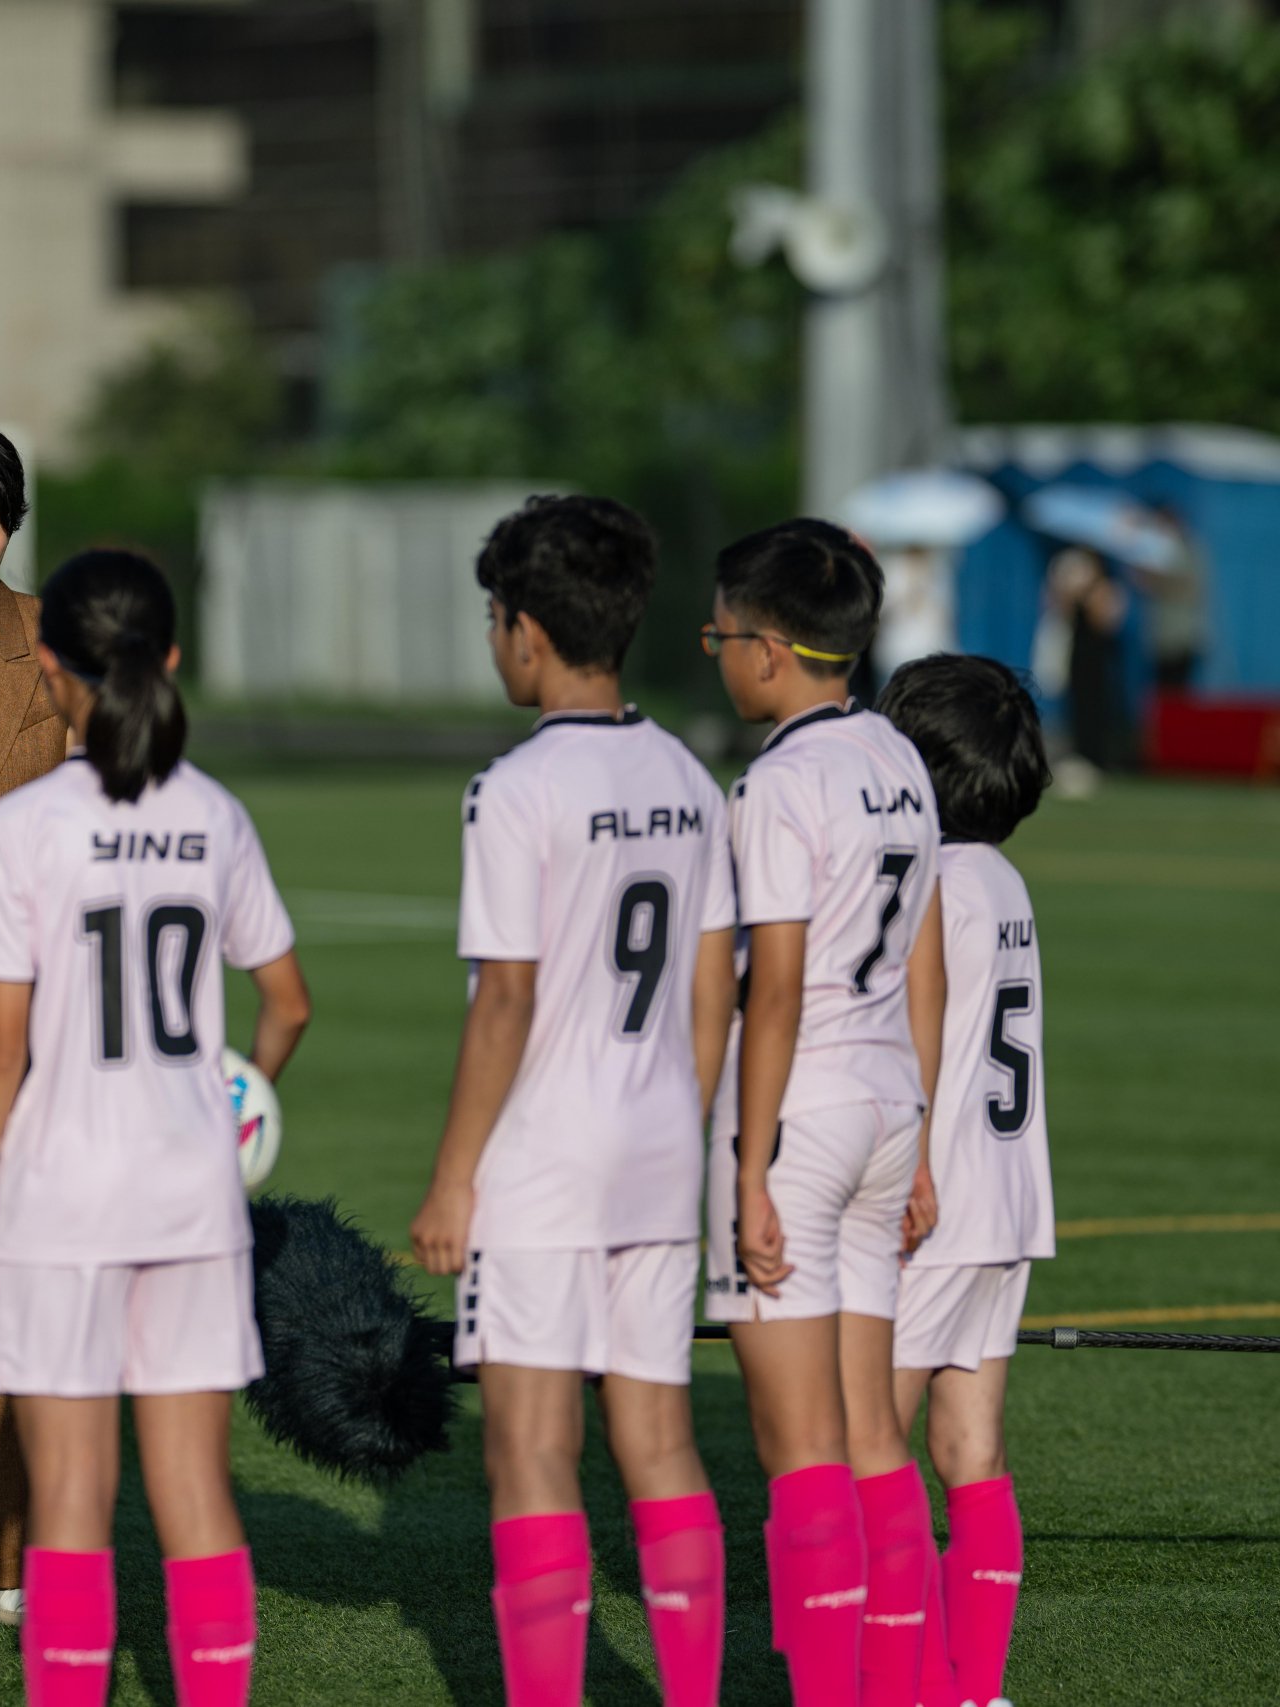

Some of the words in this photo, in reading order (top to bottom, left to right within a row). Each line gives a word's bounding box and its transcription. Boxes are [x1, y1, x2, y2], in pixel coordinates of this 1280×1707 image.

[91, 830, 207, 862] YING
[589, 807, 704, 842] ALAM
[78, 897, 213, 1067] 10
[608, 874, 675, 1039] 9
[851, 847, 918, 995] 7
[984, 979, 1035, 1138] 5
